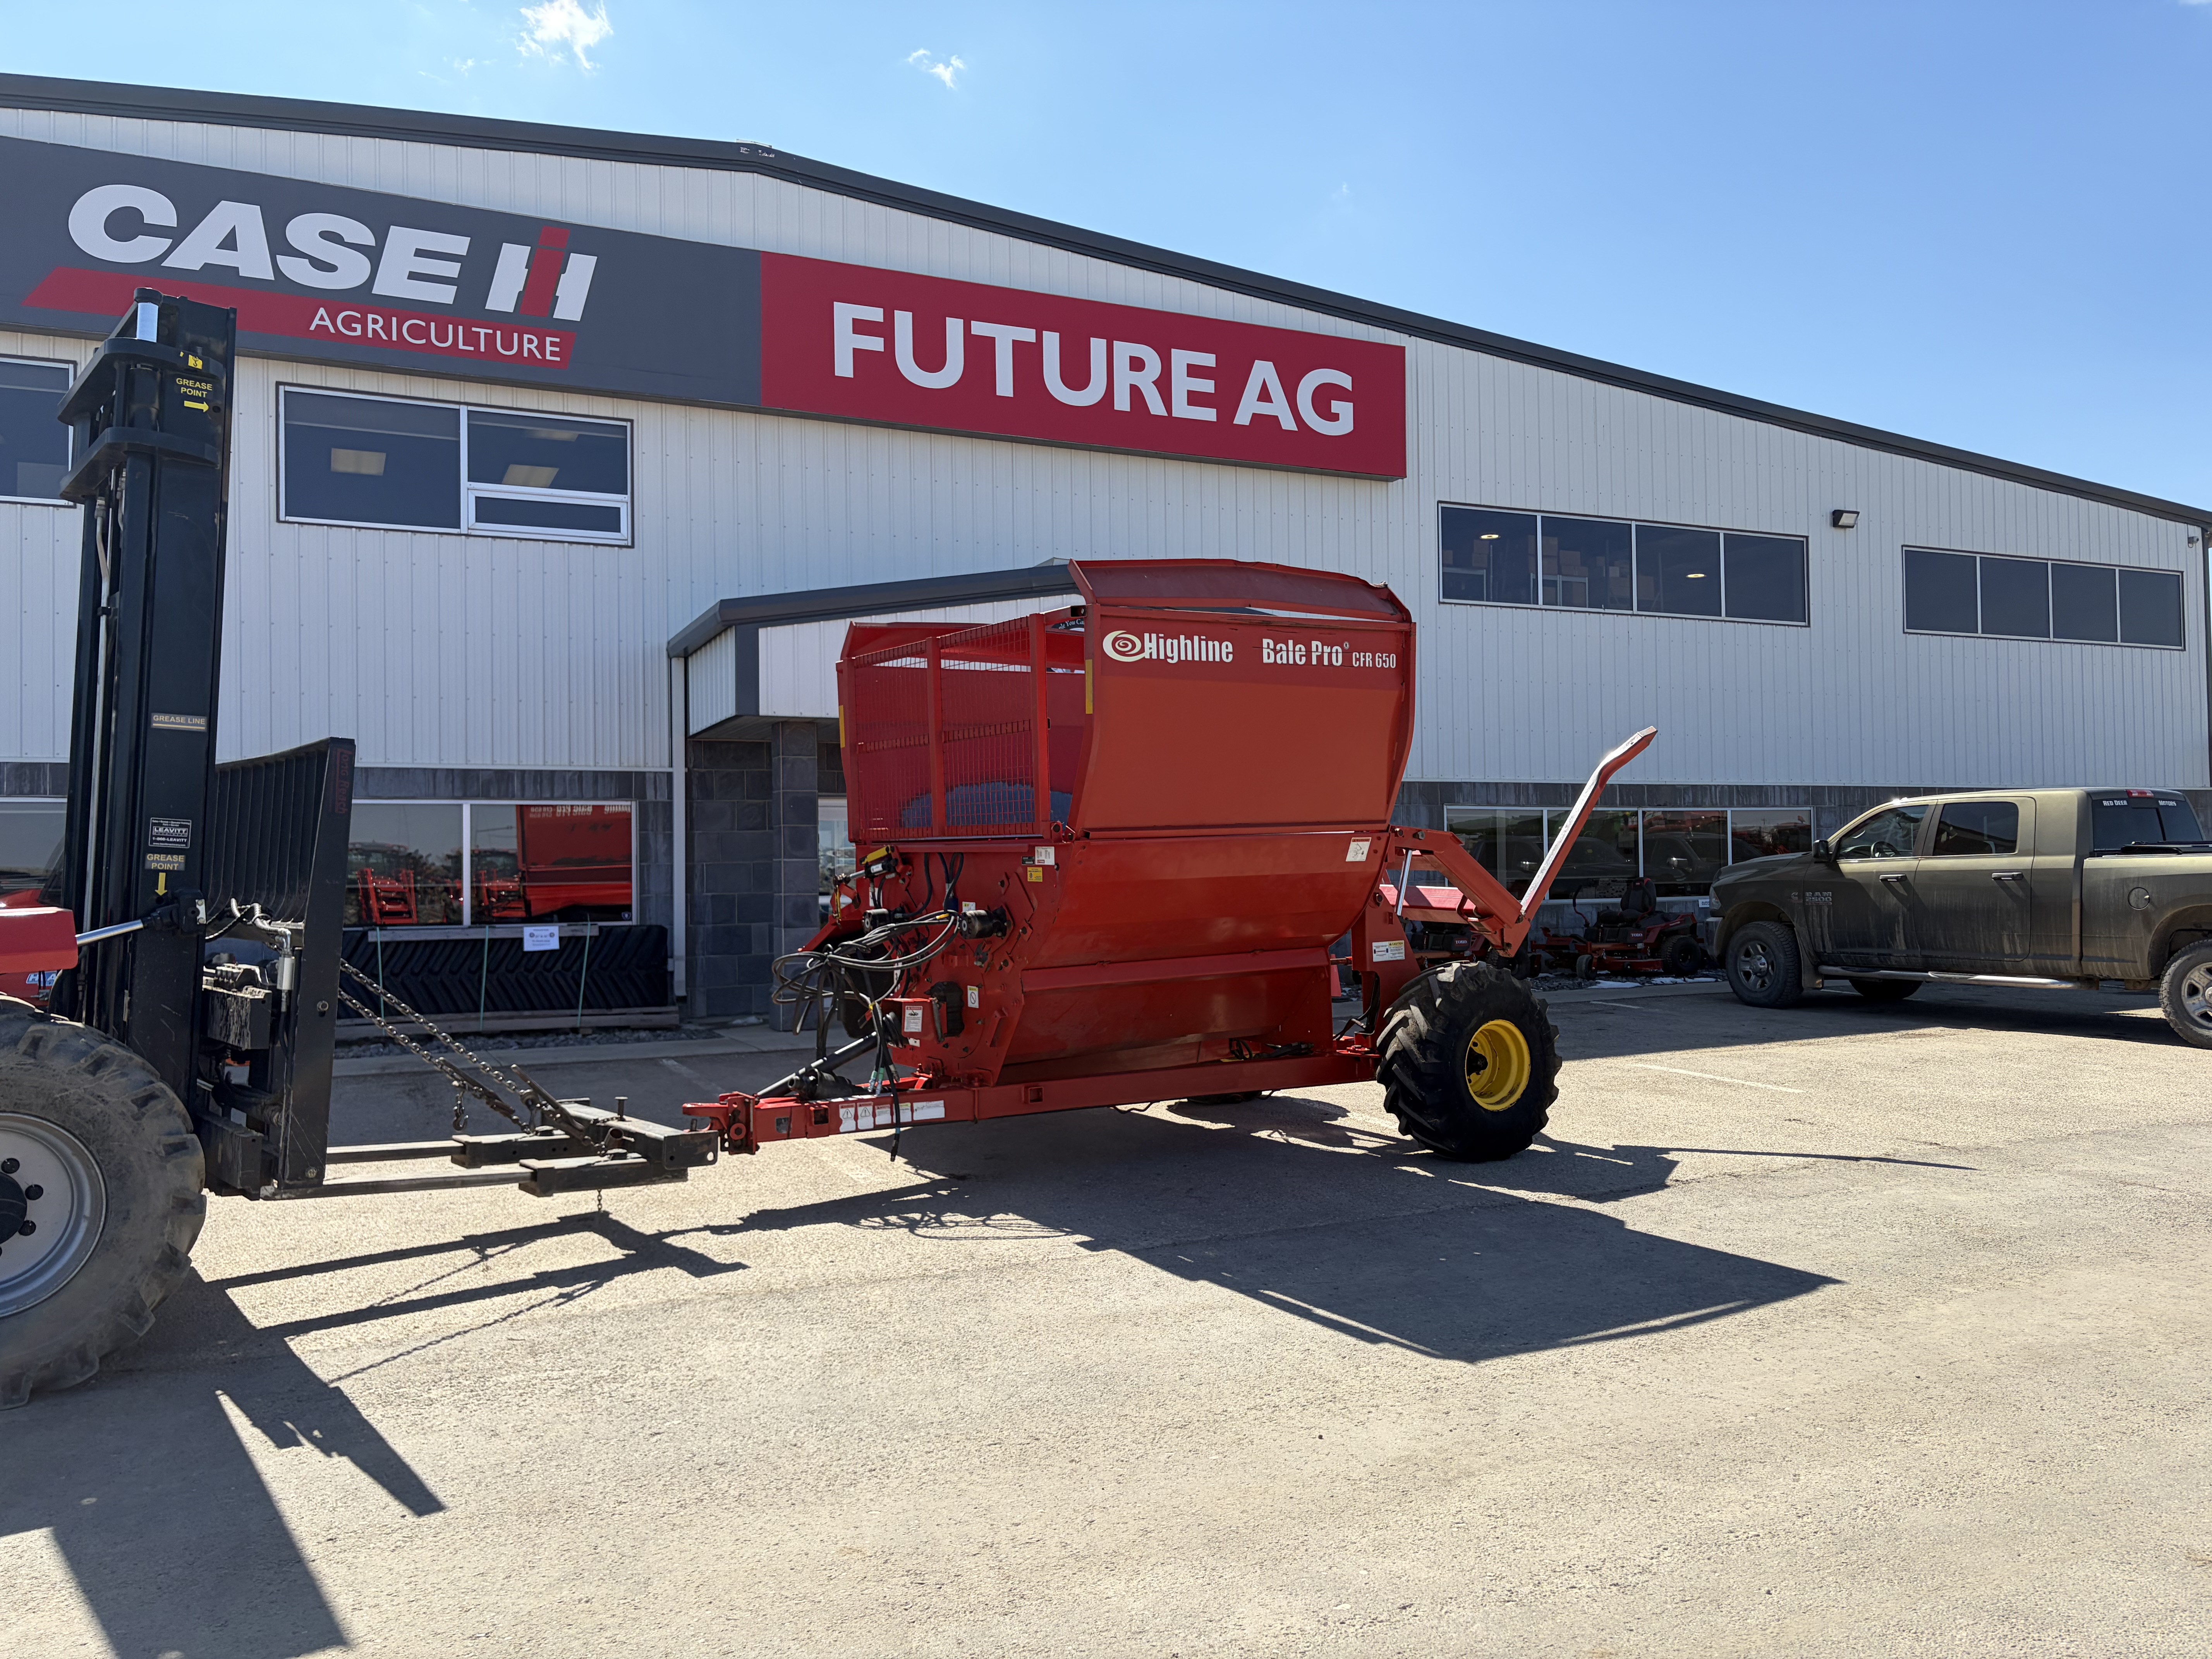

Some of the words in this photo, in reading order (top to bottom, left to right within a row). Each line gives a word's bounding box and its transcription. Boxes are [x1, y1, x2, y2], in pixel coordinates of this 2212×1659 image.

[68, 184, 471, 305] CASE
[485, 227, 597, 321] IH
[309, 307, 562, 362] AGRICULTURE
[176, 378, 213, 391] GREASE
[833, 301, 1218, 422] FUTURE
[1233, 360, 1354, 436] AG
[181, 387, 207, 398] POINT
[1144, 633, 1233, 663] Highline
[1262, 639, 1306, 665] Bale
[1353, 652, 1372, 667] CFR
[1376, 653, 1396, 668] 650
[147, 854, 184, 862] GREASE
